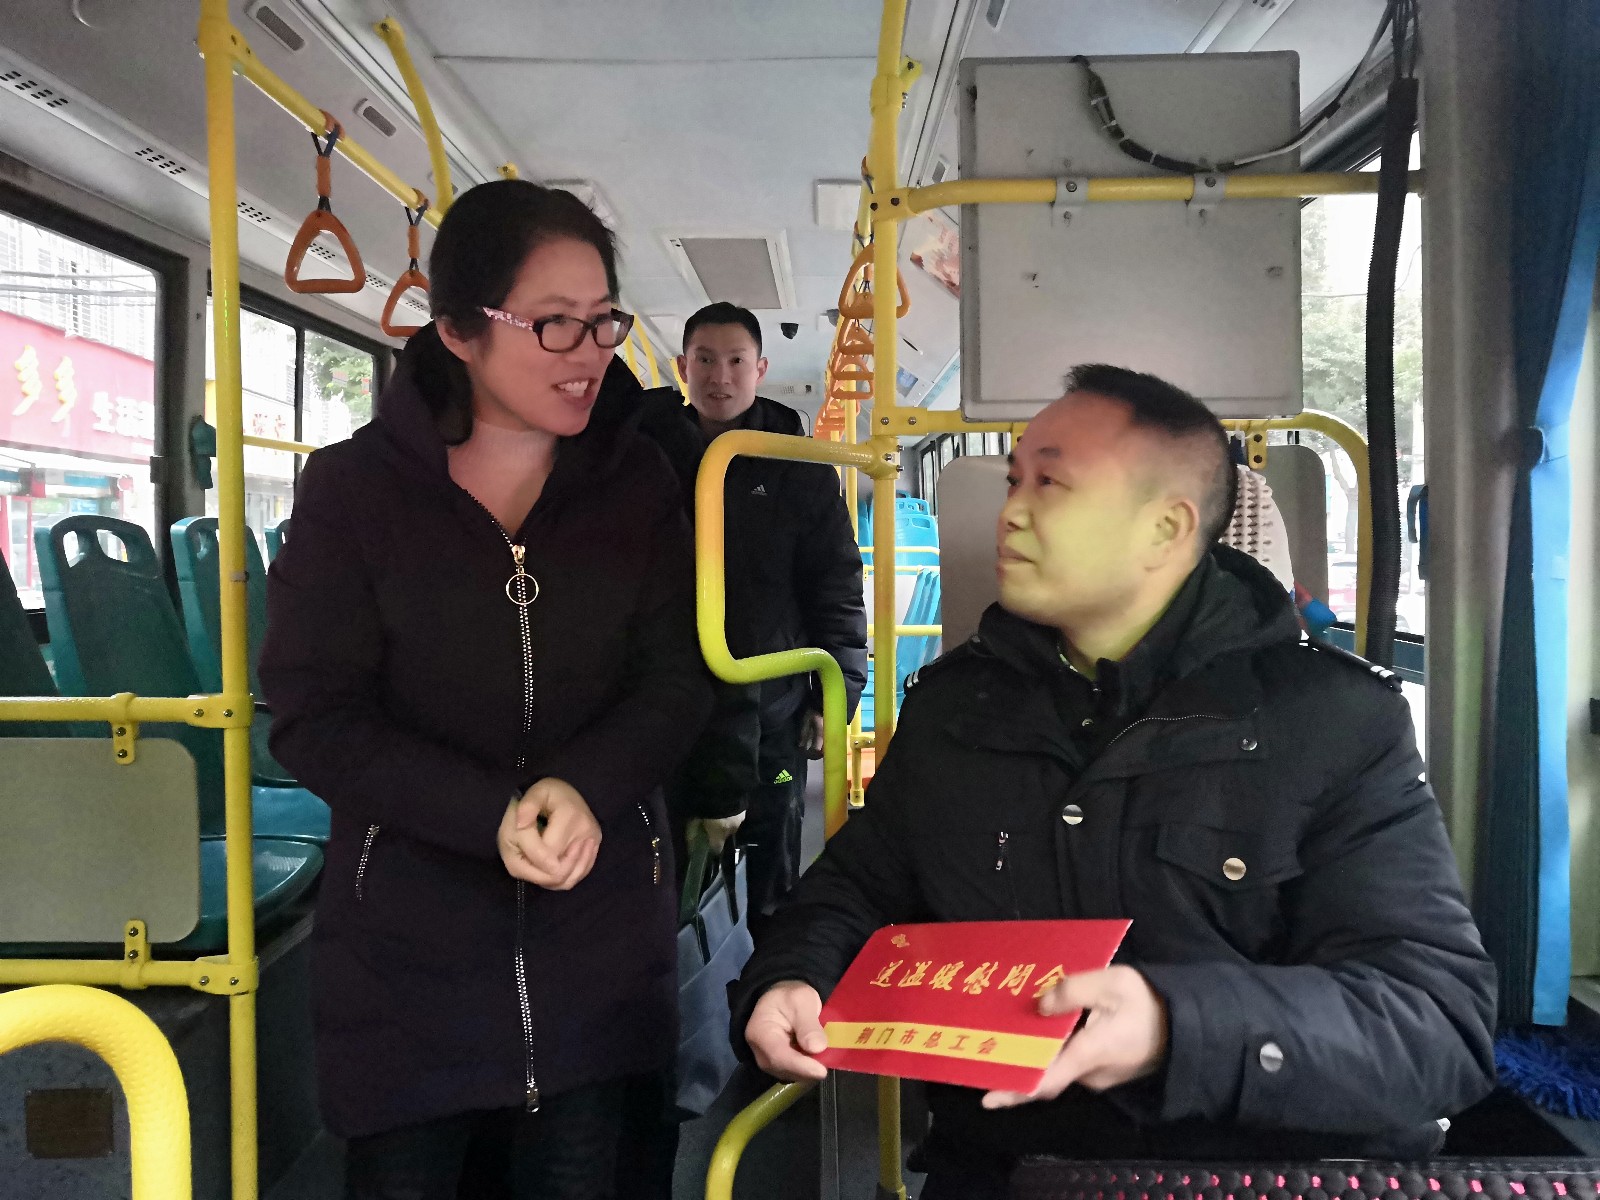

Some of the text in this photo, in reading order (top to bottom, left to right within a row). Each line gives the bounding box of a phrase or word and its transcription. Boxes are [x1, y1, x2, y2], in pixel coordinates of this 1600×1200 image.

[854, 1026, 998, 1055] 荆门市总工会
